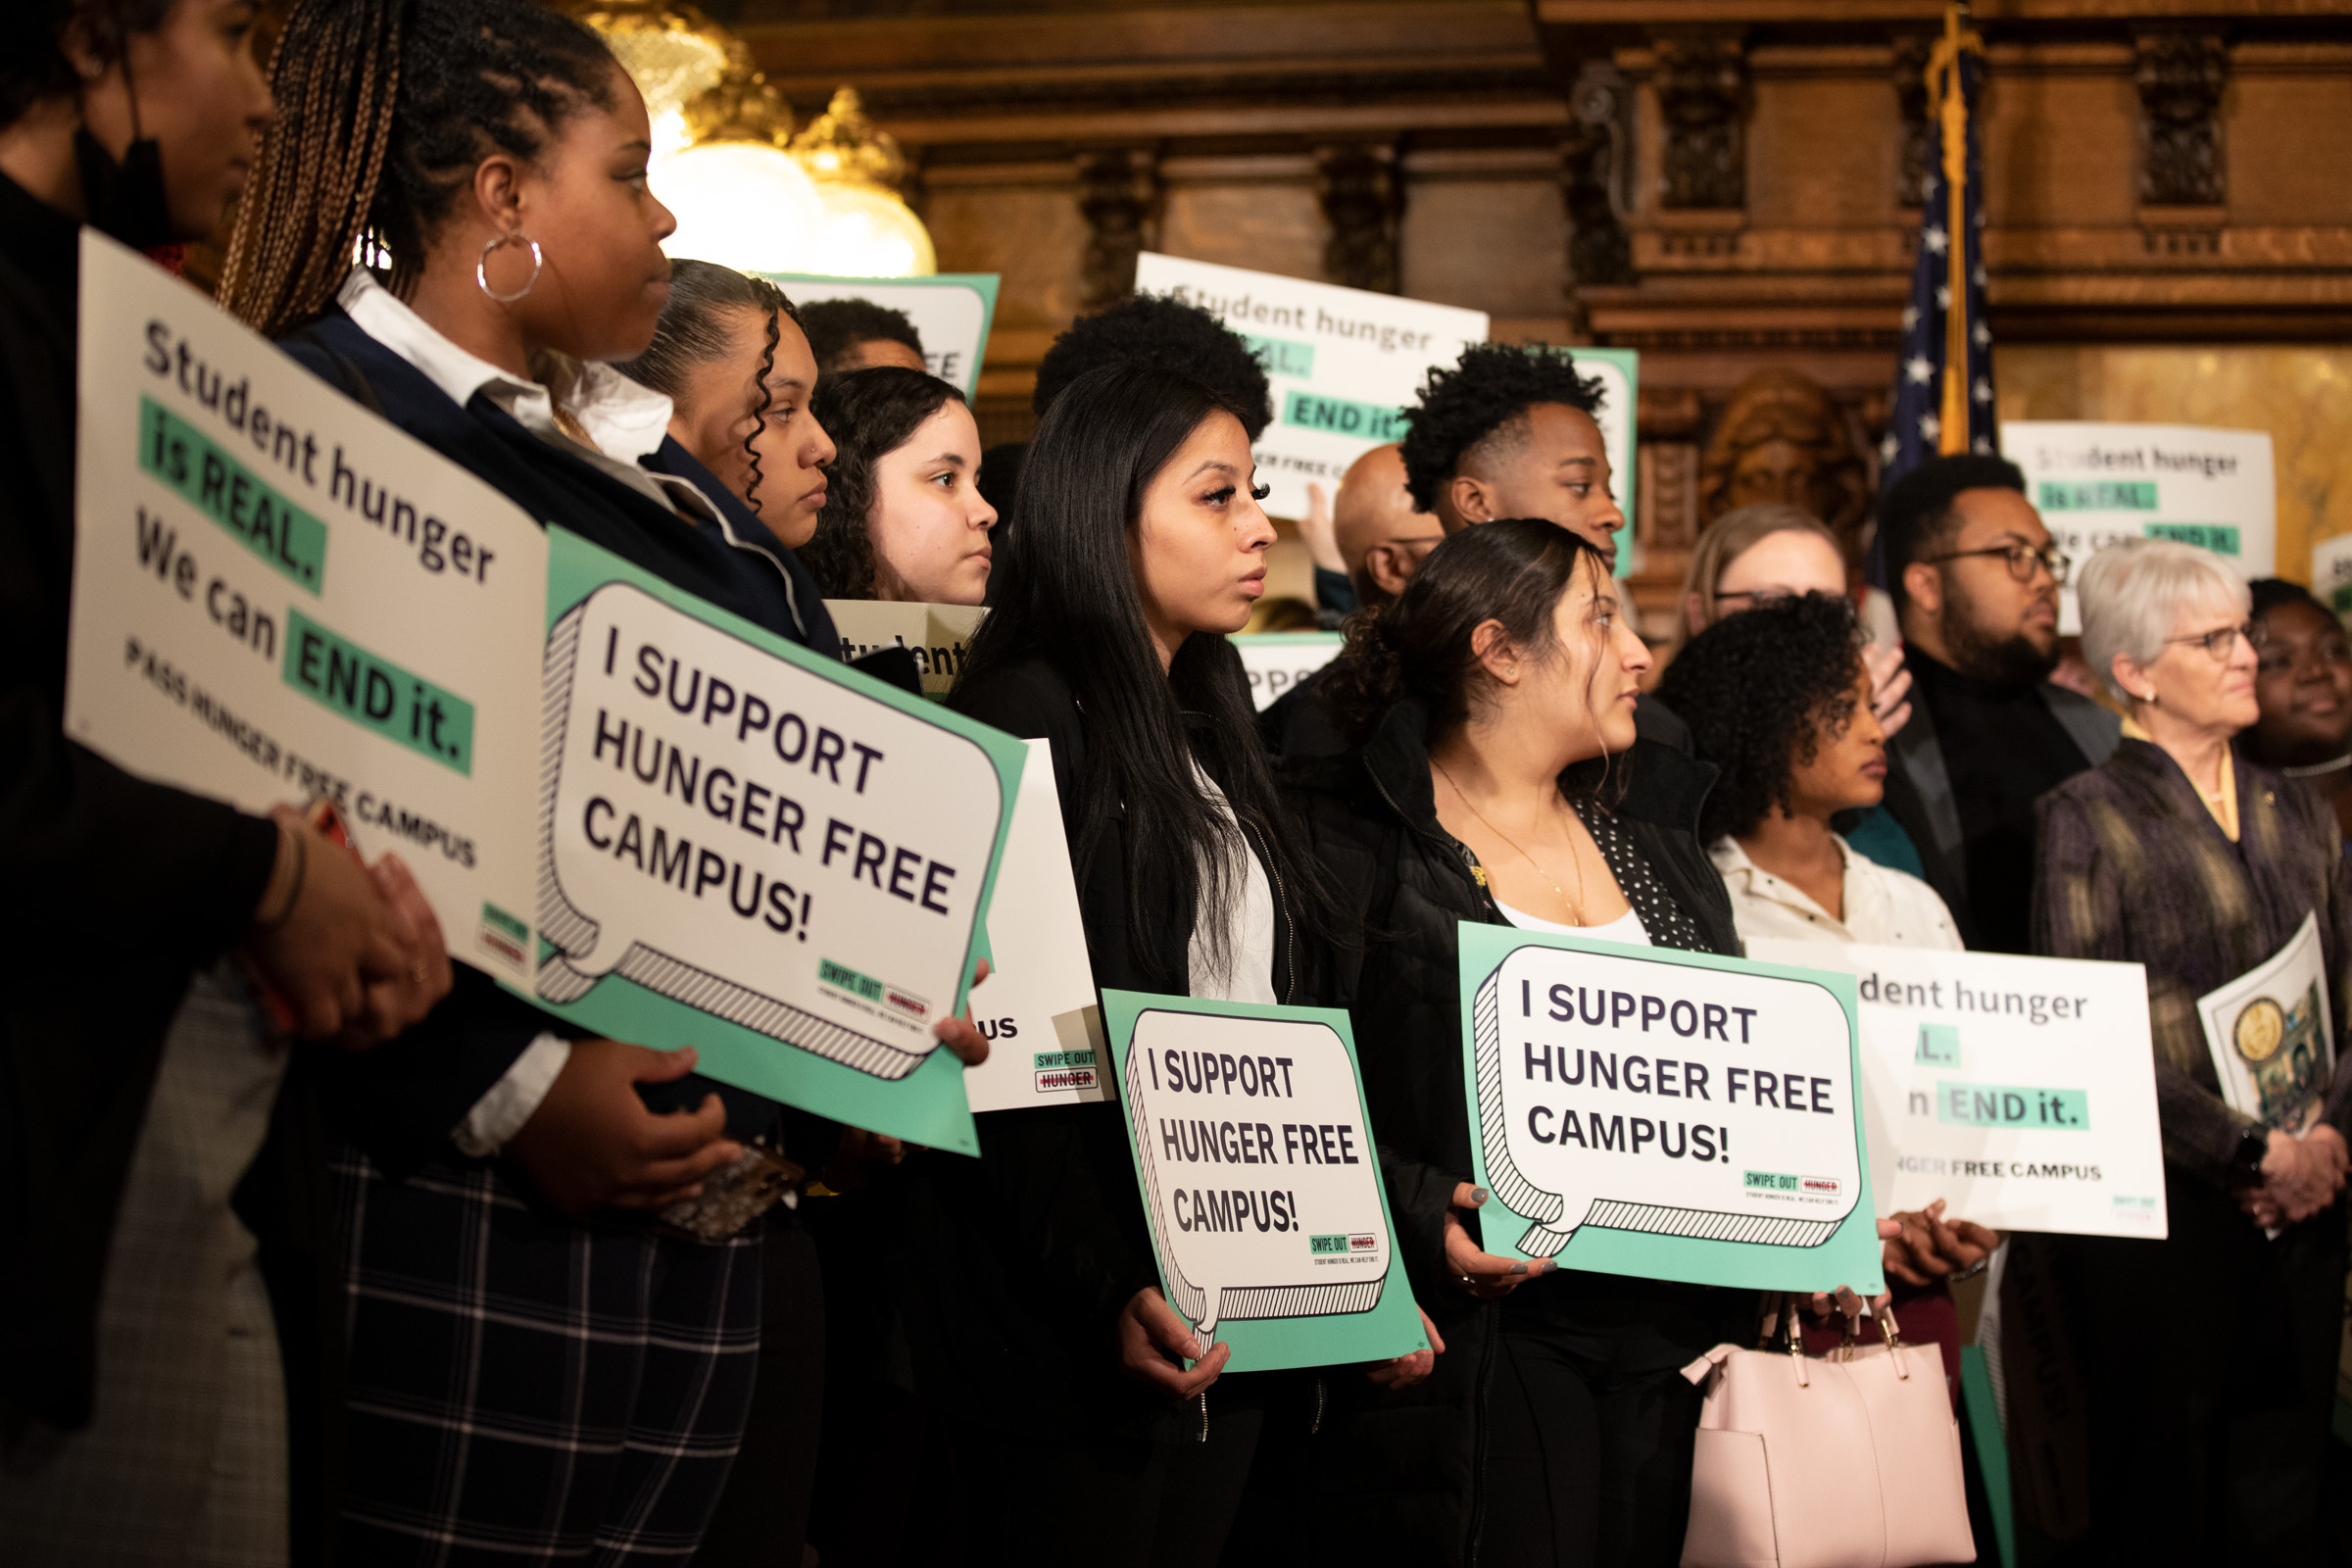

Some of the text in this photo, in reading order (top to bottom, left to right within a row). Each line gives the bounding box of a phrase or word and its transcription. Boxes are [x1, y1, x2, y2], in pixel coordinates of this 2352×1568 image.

[1316, 308, 1433, 353] hunger
[1294, 397, 1362, 432] END
[145, 318, 495, 585] Student hunger
[154, 412, 314, 580] is REAL.
[136, 505, 460, 760] We can END it.
[604, 625, 884, 796] I SUPPORT
[124, 636, 187, 707] PASS
[191, 693, 279, 774] HUNGER
[355, 791, 477, 871] CAMPUS
[593, 709, 956, 916] HUNGER FREE
[582, 797, 812, 943] CAMPUS!
[823, 962, 856, 992] SWIPE
[1860, 973, 2089, 1025] dent hunger
[1521, 979, 1758, 1045] I SUPPORT
[1038, 1052, 1096, 1067] SWIPE OUT
[1042, 1071, 1092, 1089] HUNGER
[1148, 1047, 1294, 1099] I SUPPORT
[1524, 1042, 1835, 1114] HUNGER FREE
[1949, 1089, 2028, 1123] END
[2038, 1092, 2080, 1125] it.
[1159, 1118, 1360, 1165] HUNGER FREE
[1526, 1104, 1731, 1164] CAMPUS!
[1746, 1173, 1838, 1193] SWIPE OUT HUNGER
[1951, 1159, 2006, 1178] FREE
[2009, 1162, 2103, 1182] CAMPUS
[1173, 1188, 1300, 1233] CAMPUS!
[1311, 1236, 1376, 1252] SWIPE OUT HUNGER
